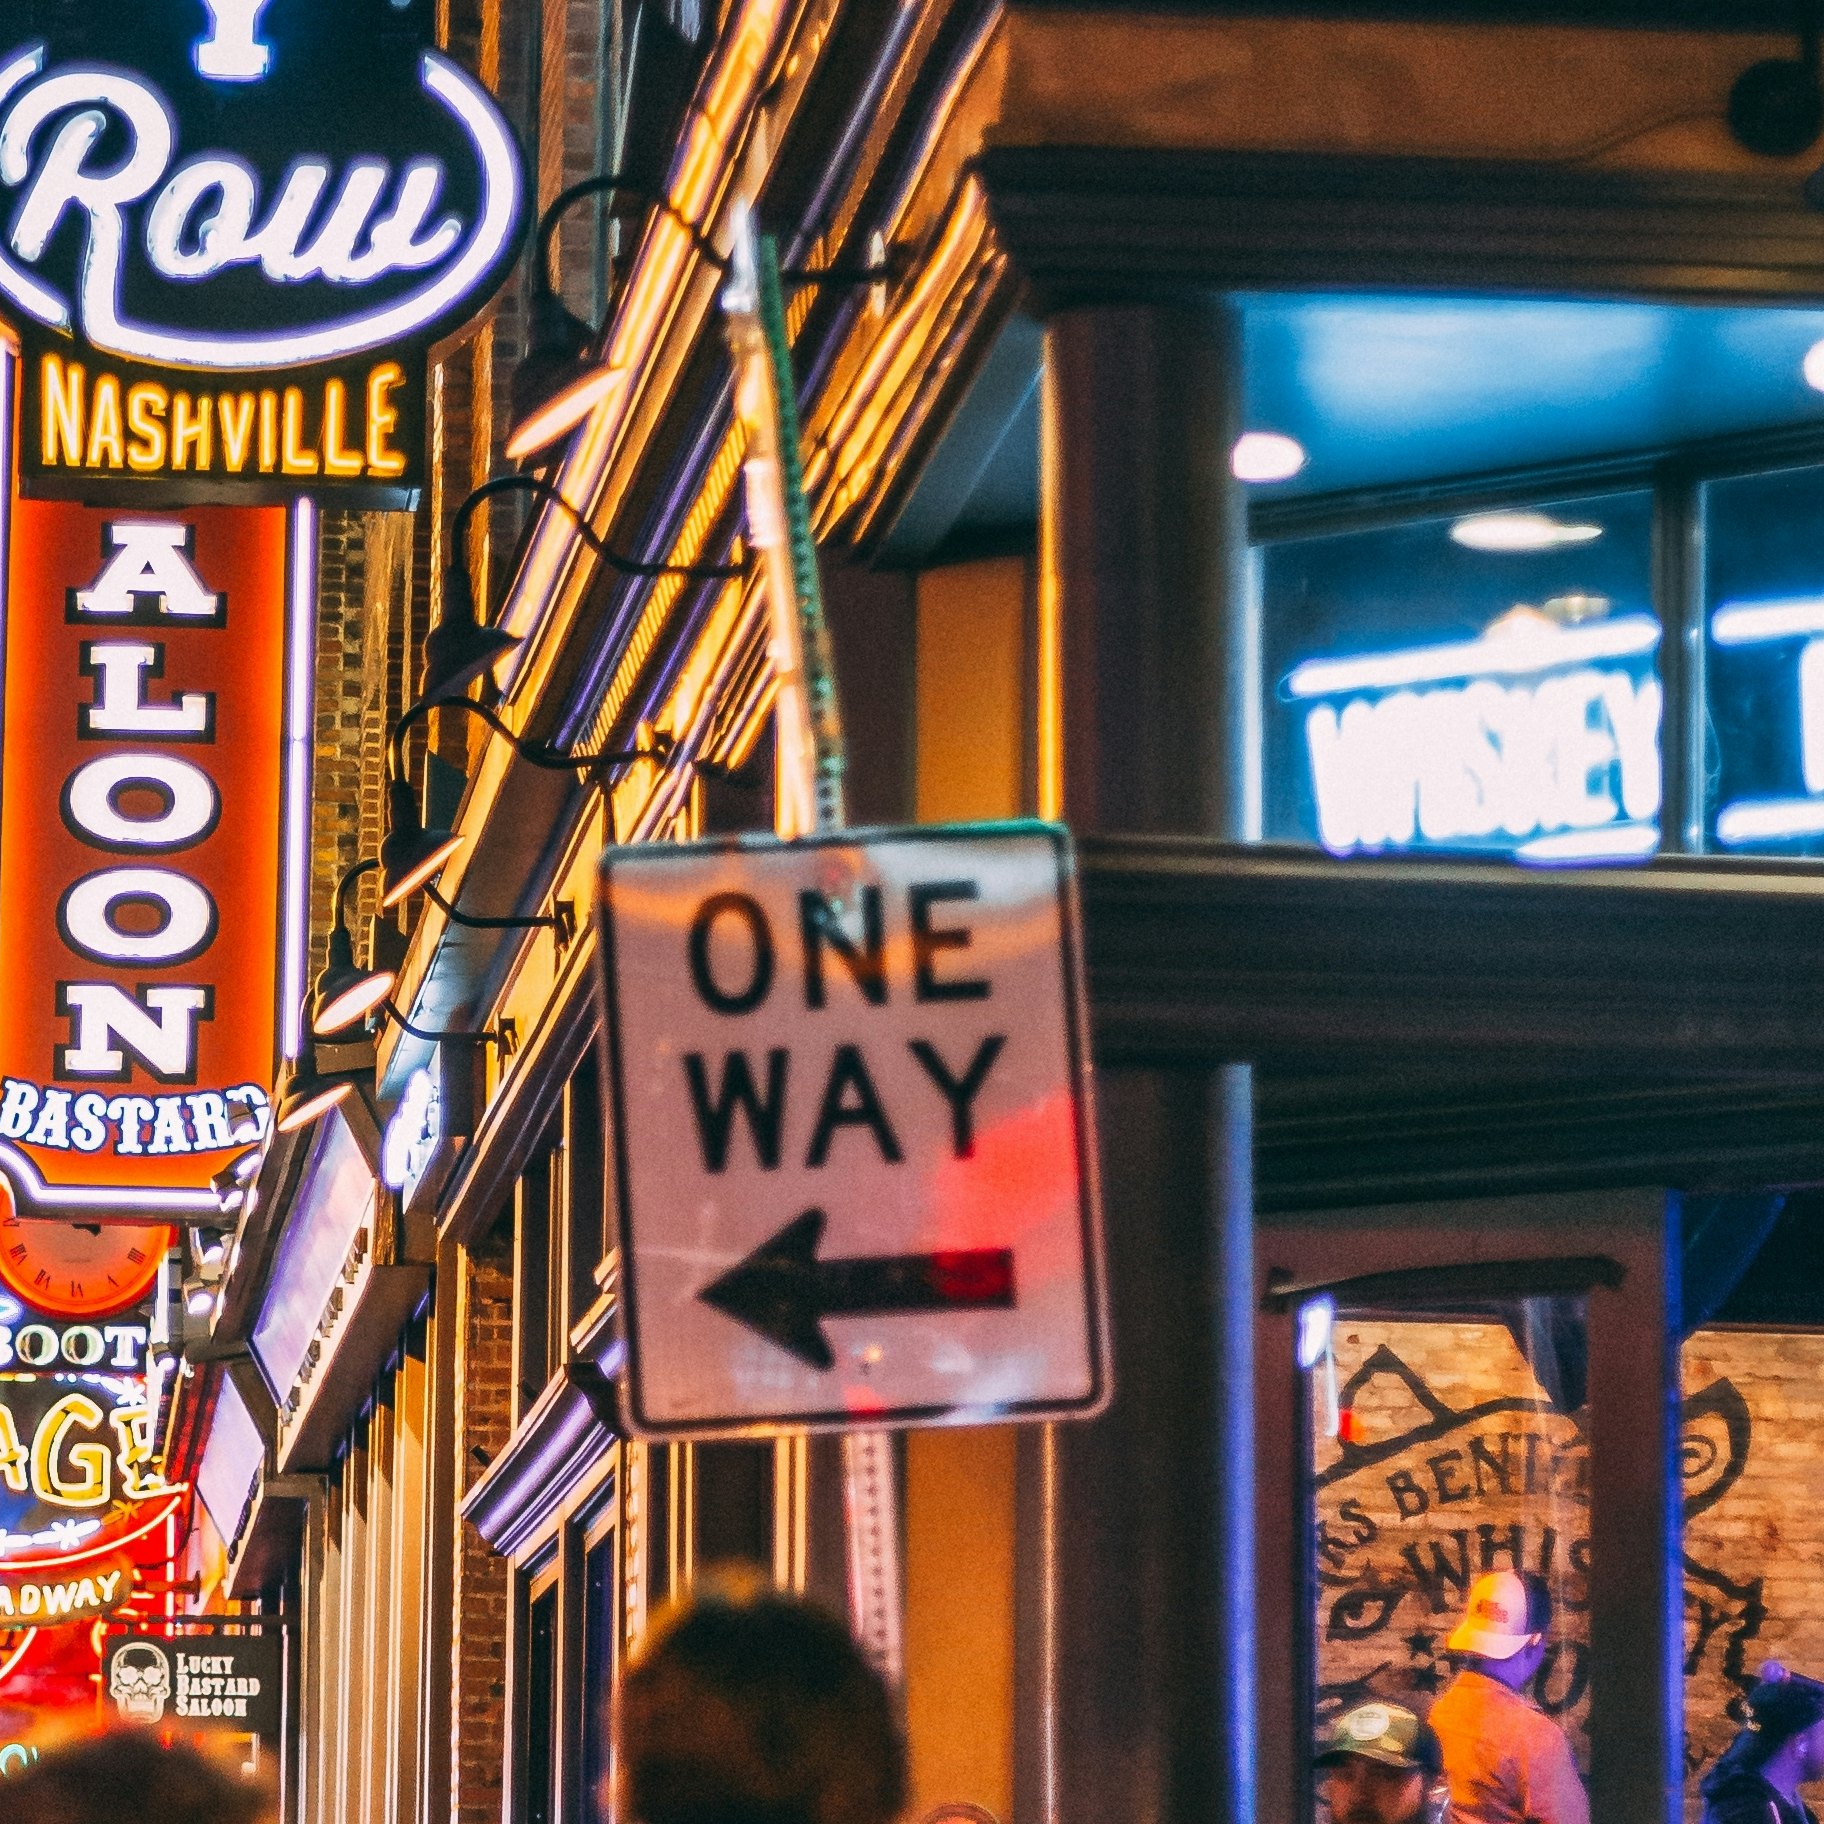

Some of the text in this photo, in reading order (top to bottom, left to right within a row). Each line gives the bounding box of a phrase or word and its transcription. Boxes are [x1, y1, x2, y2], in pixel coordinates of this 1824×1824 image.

[41, 352, 405, 478] NASHVILLE
[64, 521, 221, 1075] ALOON
[687, 879, 992, 1014] ONE
[681, 1034, 1008, 1174] WAY
[175, 1652, 234, 1676] LUCKY
[175, 1674, 261, 1698] BASTARD
[175, 1696, 249, 1718] SALOON
